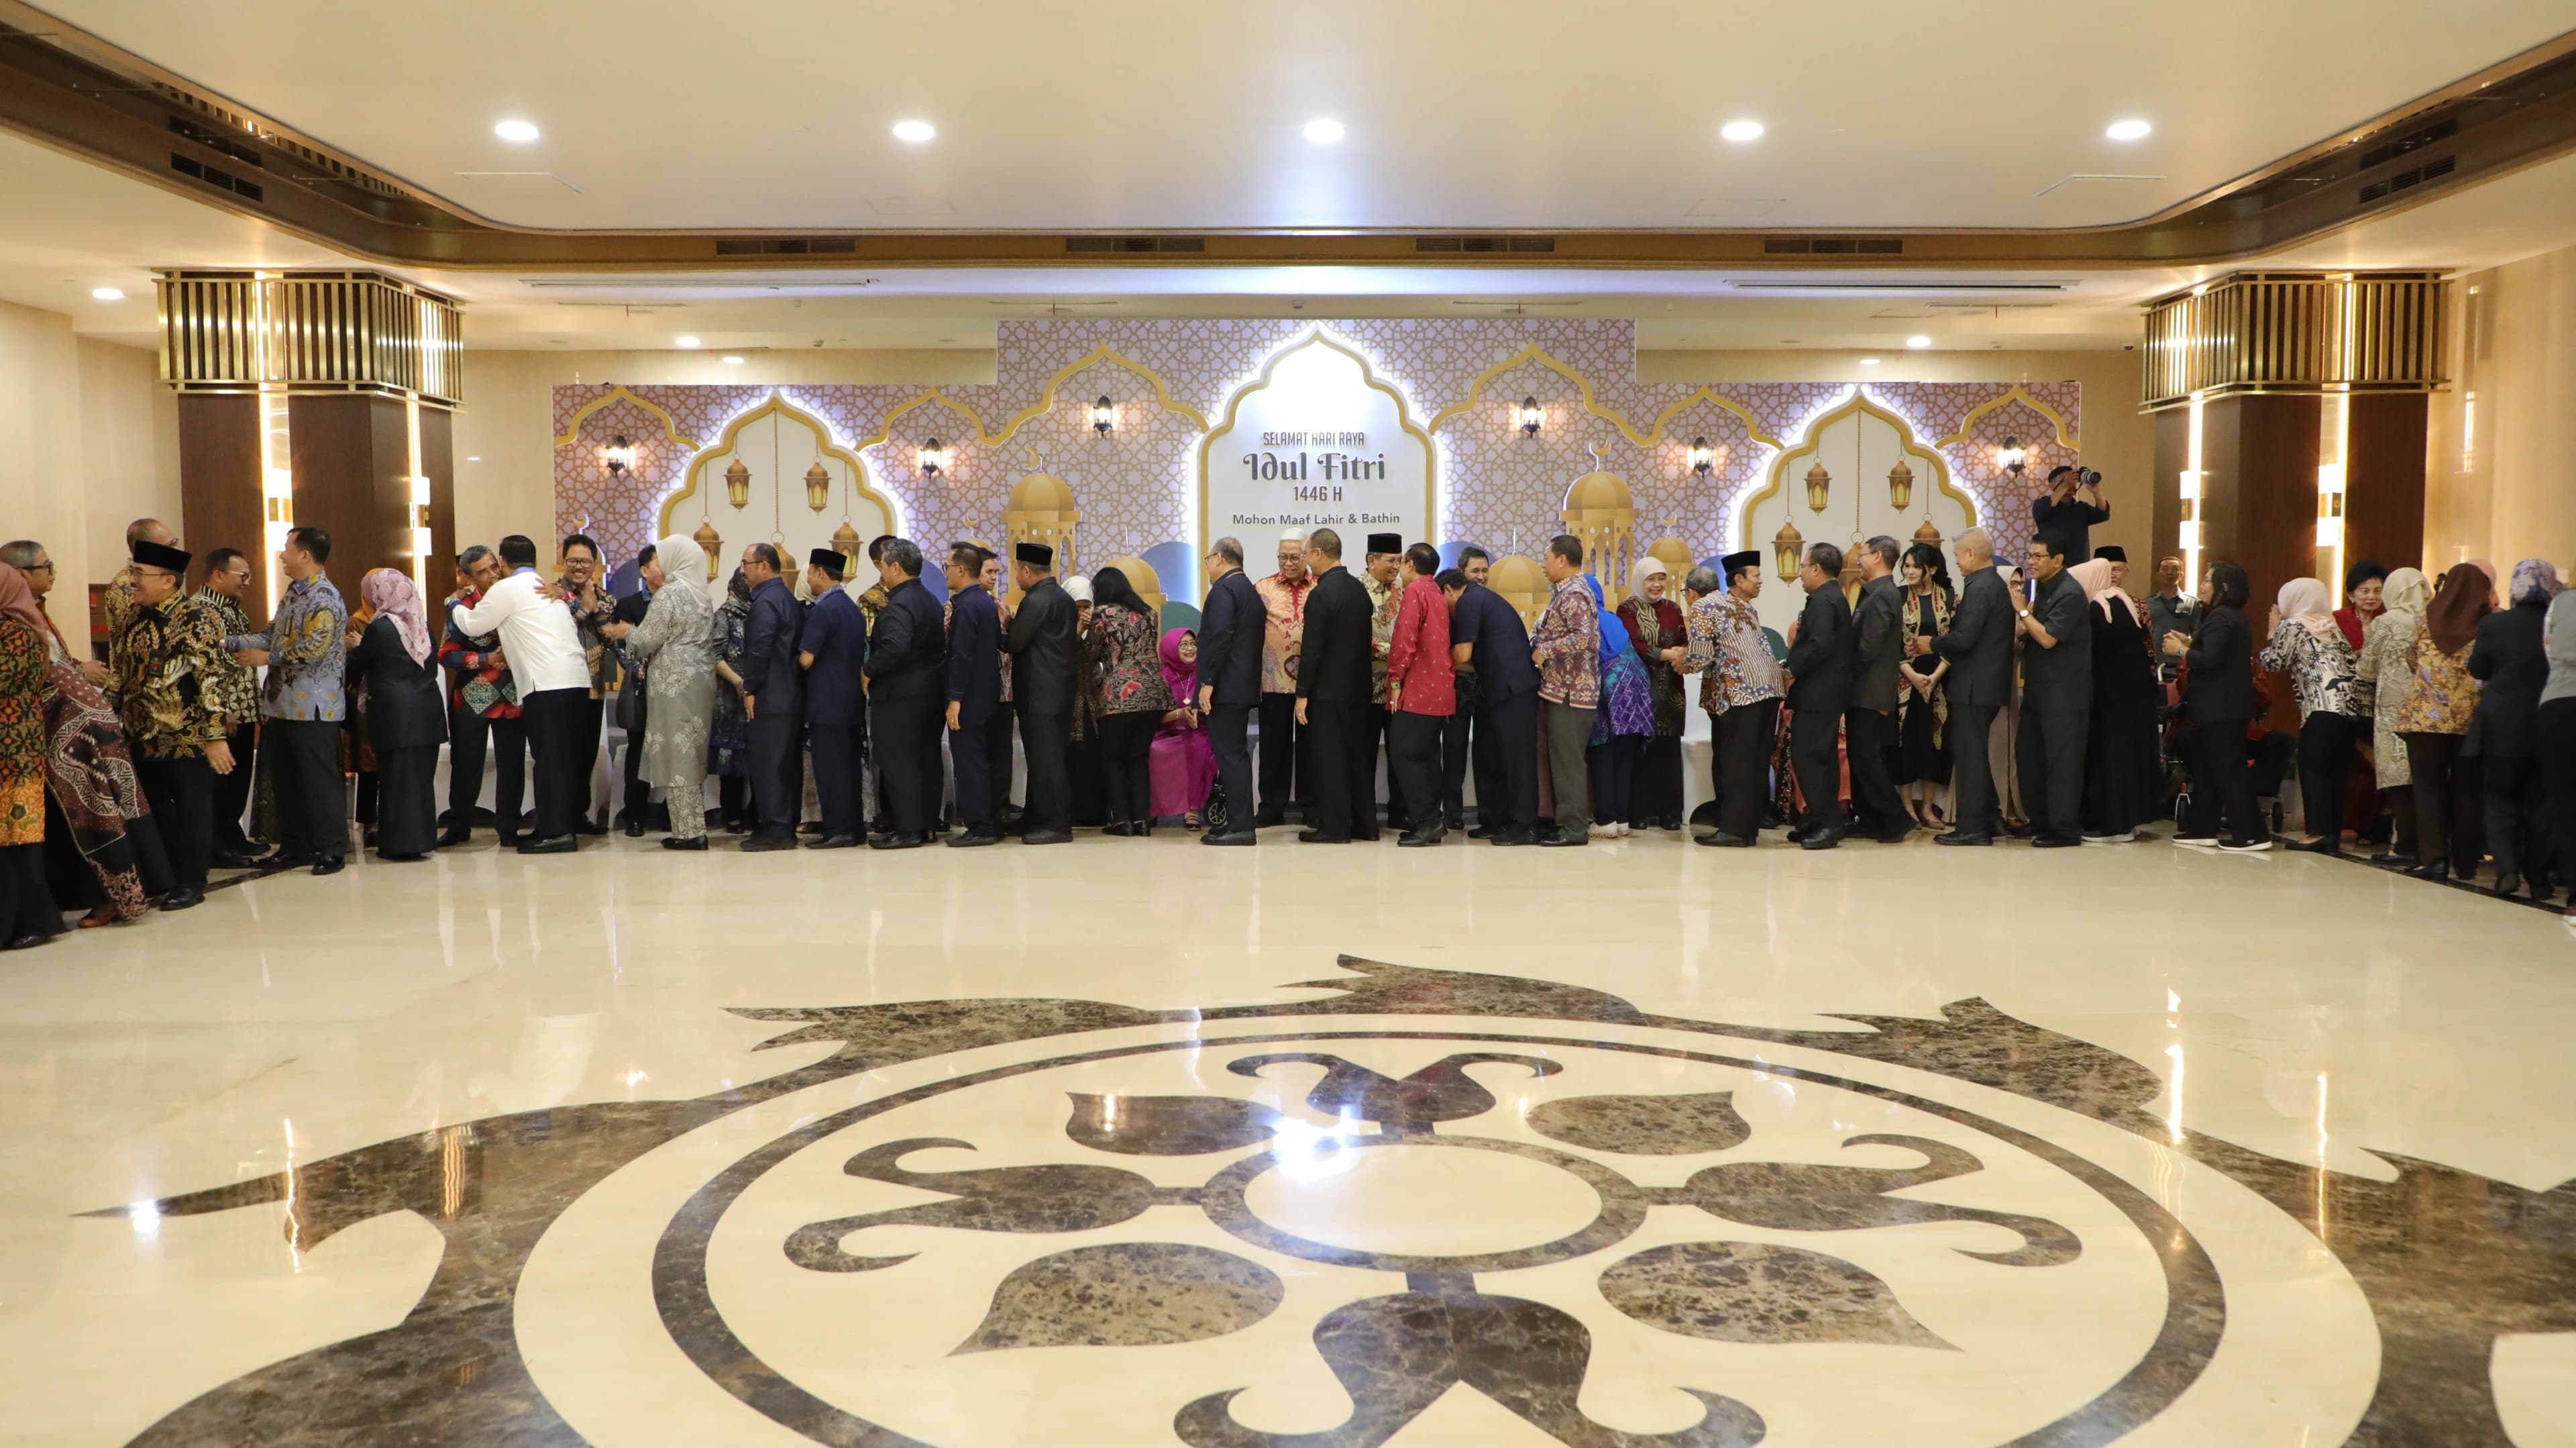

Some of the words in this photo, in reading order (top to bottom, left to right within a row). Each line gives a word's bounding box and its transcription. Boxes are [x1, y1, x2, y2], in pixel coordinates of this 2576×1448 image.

[1263, 431, 1307, 446] SELAMAT
[1311, 431, 1336, 446] HARI
[1339, 431, 1364, 446] RAYA
[1242, 452, 1307, 480] Idul
[1317, 452, 1385, 480] Fitri
[1293, 485, 1328, 501] 1446
[1333, 485, 1342, 502] H
[1233, 513, 1275, 525] Mohon
[1280, 513, 1310, 525] Maaf
[1314, 513, 1344, 525] Lahir
[1348, 513, 1357, 524] &
[1362, 512, 1400, 523] Bathin
